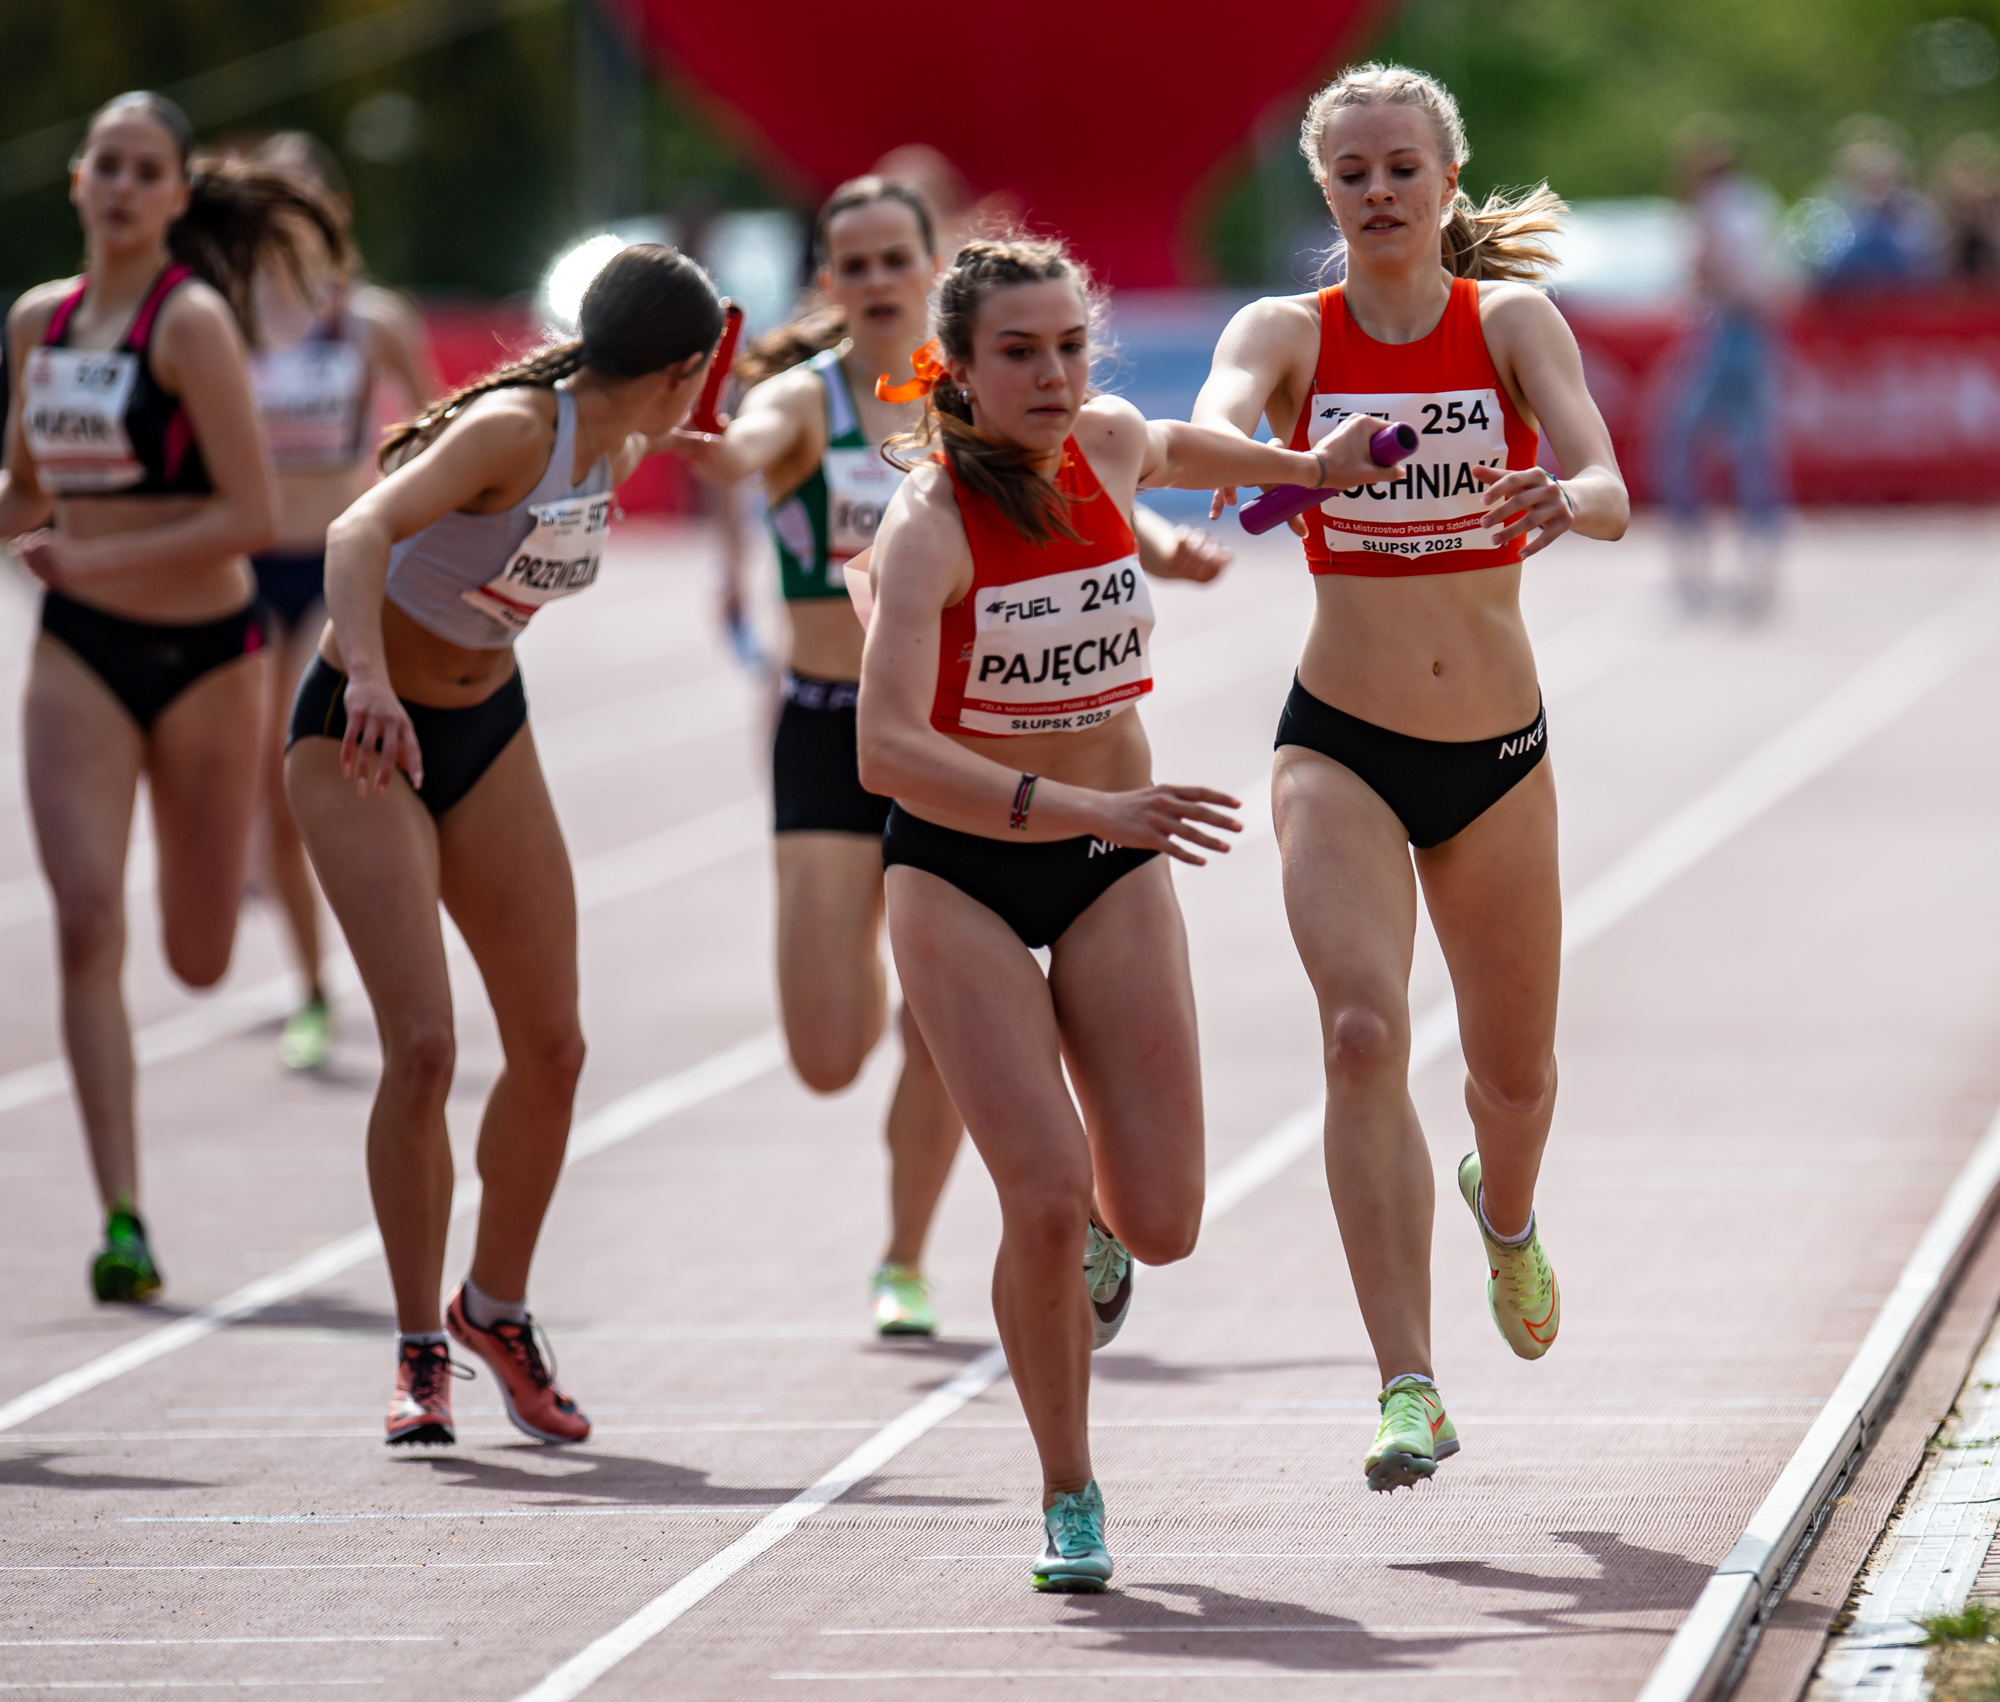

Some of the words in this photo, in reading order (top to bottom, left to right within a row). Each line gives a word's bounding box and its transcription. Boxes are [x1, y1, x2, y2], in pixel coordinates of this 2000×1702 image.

[1421, 400, 1490, 434] 254
[1332, 519, 1352, 530] PZLA
[1353, 523, 1406, 534] Mistrzostwa
[1407, 521, 1435, 533] Polski
[1446, 518, 1481, 531] Sztafeta
[1362, 540, 1422, 554] SŁUPSK
[1424, 537, 1463, 553] 2023
[1080, 568, 1136, 613] 249
[1004, 597, 1061, 623] FUEL
[978, 627, 1143, 687] PAJĘCKA
[980, 702, 1003, 712] PZLA
[1004, 703, 1061, 714] Mistrzostwa
[1062, 700, 1087, 711] Polski
[1098, 686, 1141, 704] Sztafetach
[1011, 717, 1074, 730] SŁUPSK
[1076, 709, 1112, 728] 2023
[1498, 718, 1544, 760] NIKE
